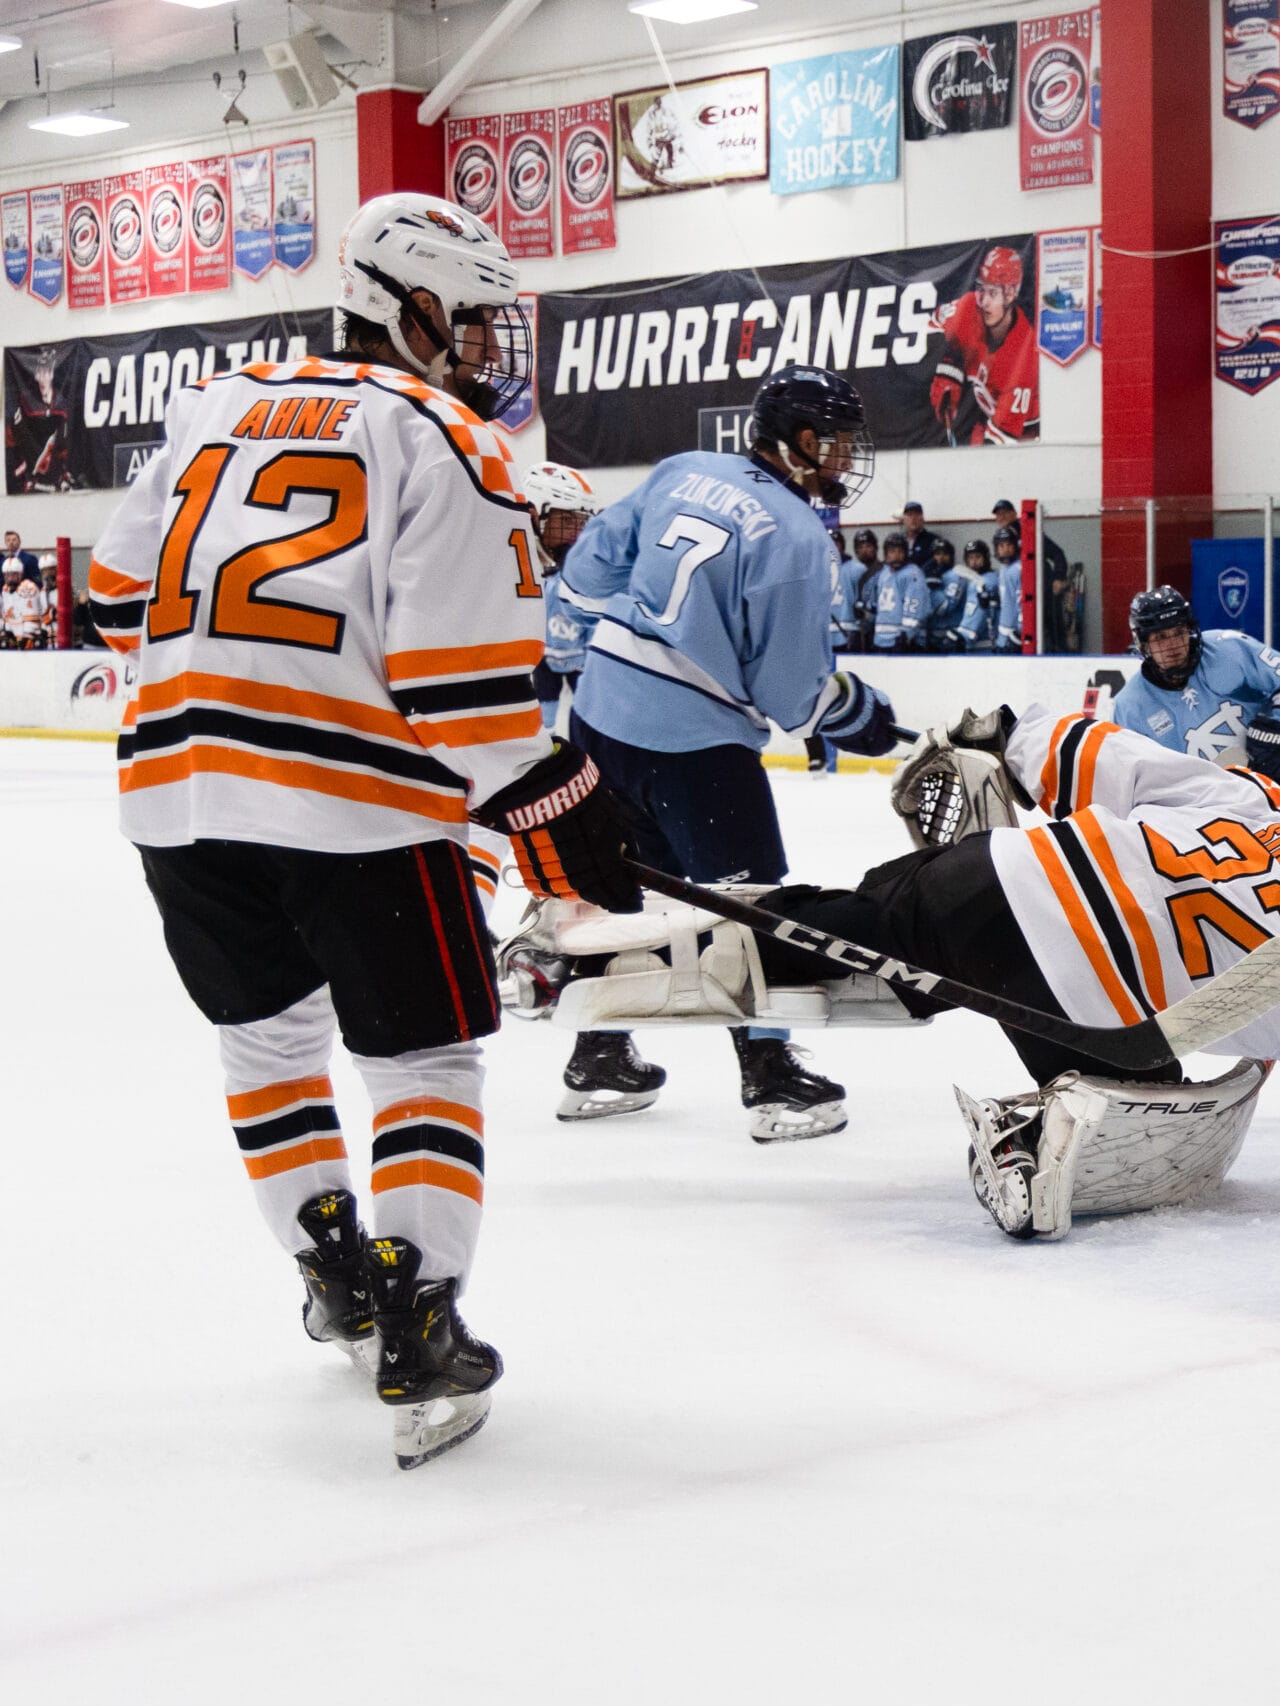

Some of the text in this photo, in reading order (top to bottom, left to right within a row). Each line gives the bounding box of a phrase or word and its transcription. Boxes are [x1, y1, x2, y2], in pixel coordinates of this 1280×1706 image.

[1022, 21, 1051, 50] FALL
[699, 104, 759, 127] ELON
[776, 70, 898, 141] CAROLINA
[785, 136, 888, 184] HOCKEY
[1029, 139, 1084, 158] CHAMPIONS
[553, 281, 938, 396] HURRICANES
[230, 396, 358, 441] AHNE
[1011, 387, 1031, 414] 20
[669, 473, 779, 543] ZUKOWSKI
[148, 442, 369, 655] 12
[508, 528, 543, 598] 1
[634, 513, 733, 627] 7
[773, 919, 943, 995] CCM
[1117, 1099, 1219, 1115] TRUE
